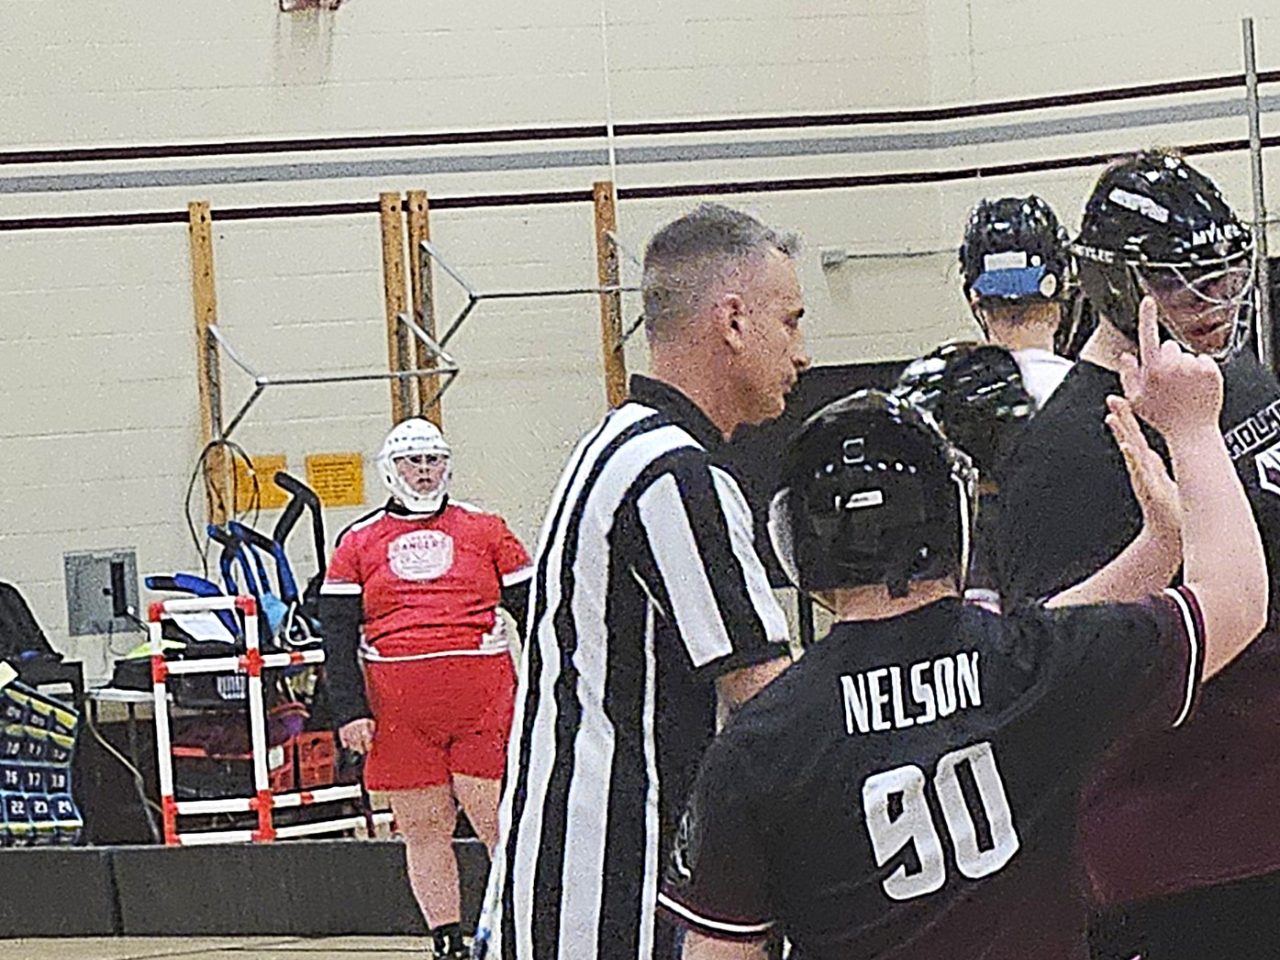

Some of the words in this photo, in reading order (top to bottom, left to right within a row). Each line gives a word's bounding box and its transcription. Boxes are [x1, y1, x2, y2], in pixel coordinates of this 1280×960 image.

[841, 651, 981, 734] NELSON
[28, 771, 41, 786] 17
[862, 740, 1020, 900] 90
